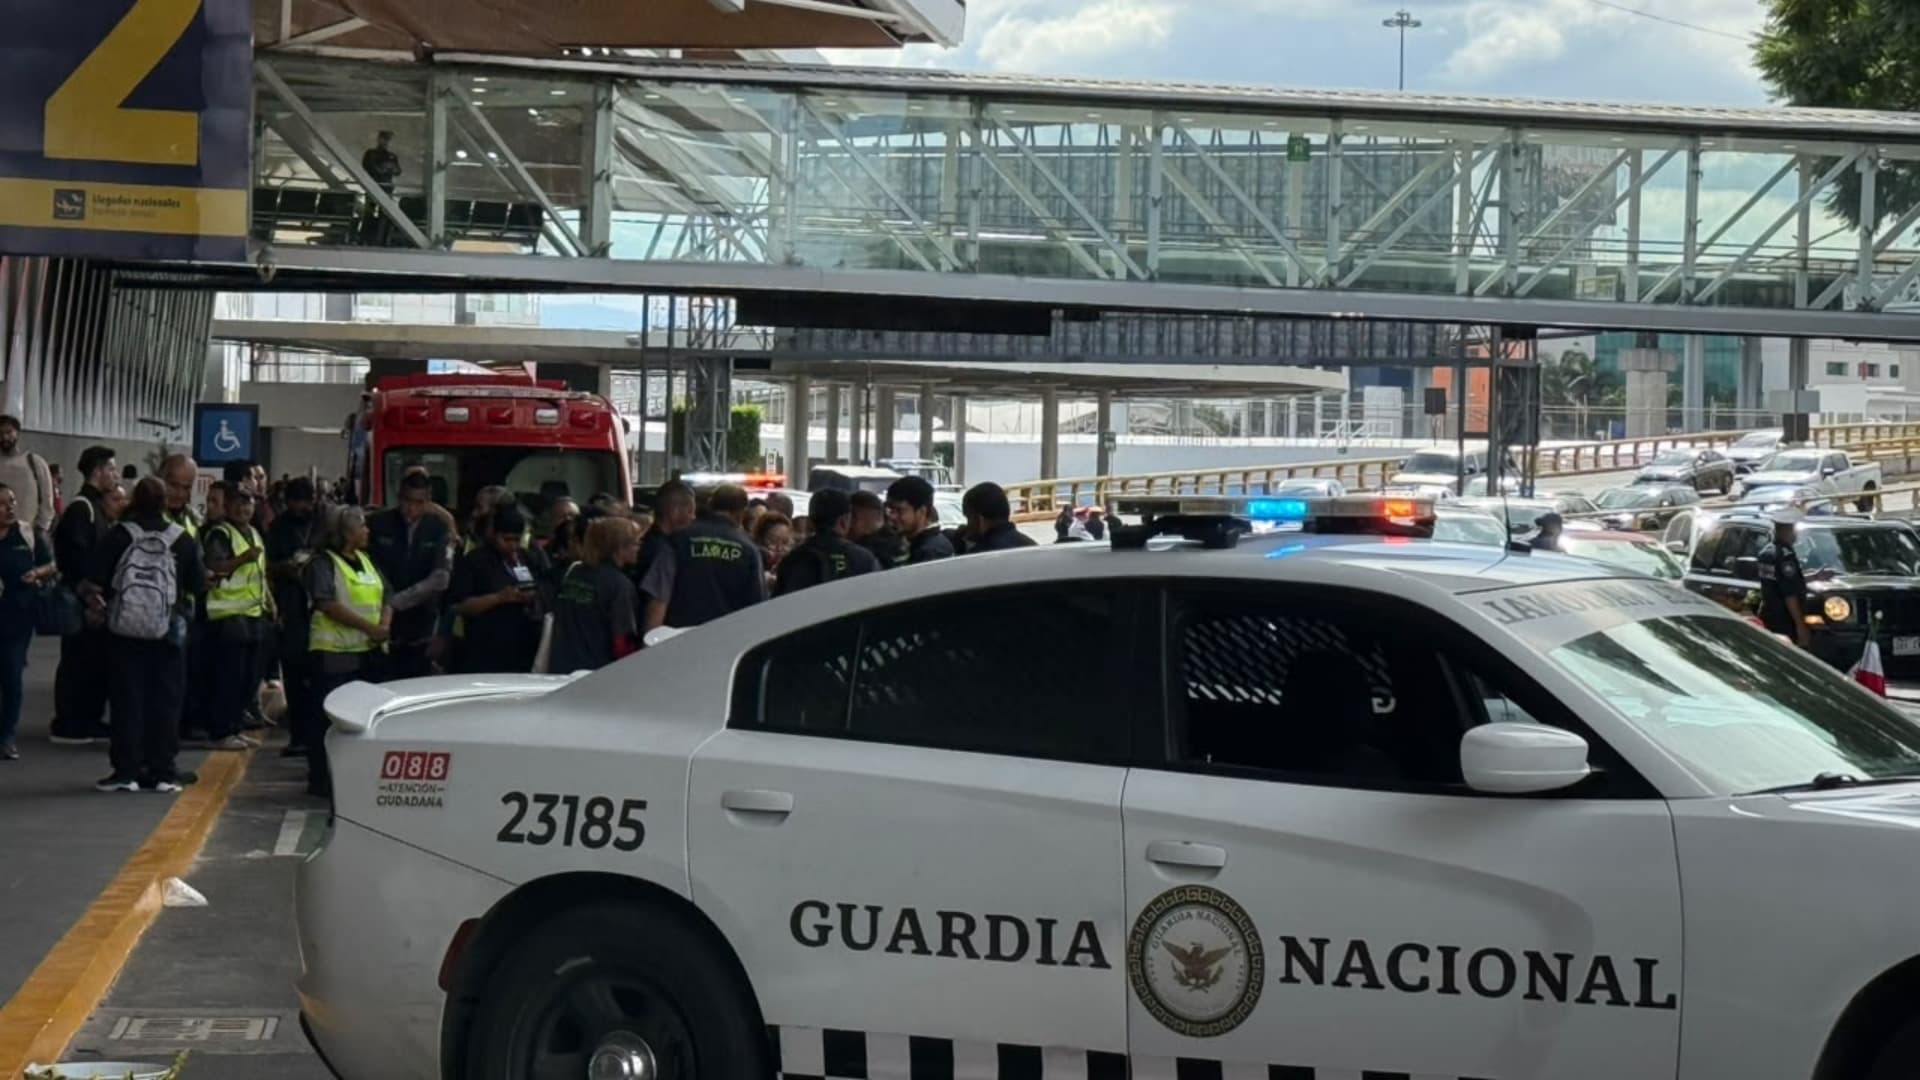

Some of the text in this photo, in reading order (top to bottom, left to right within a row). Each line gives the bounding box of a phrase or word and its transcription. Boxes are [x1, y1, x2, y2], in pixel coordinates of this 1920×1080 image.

[44, 0, 202, 165] 2
[385, 754, 445, 778] 088
[376, 795, 443, 807] CIUDADANA
[497, 791, 648, 851] 23185
[790, 900, 1677, 1010] GUARDIA NACIONAL
